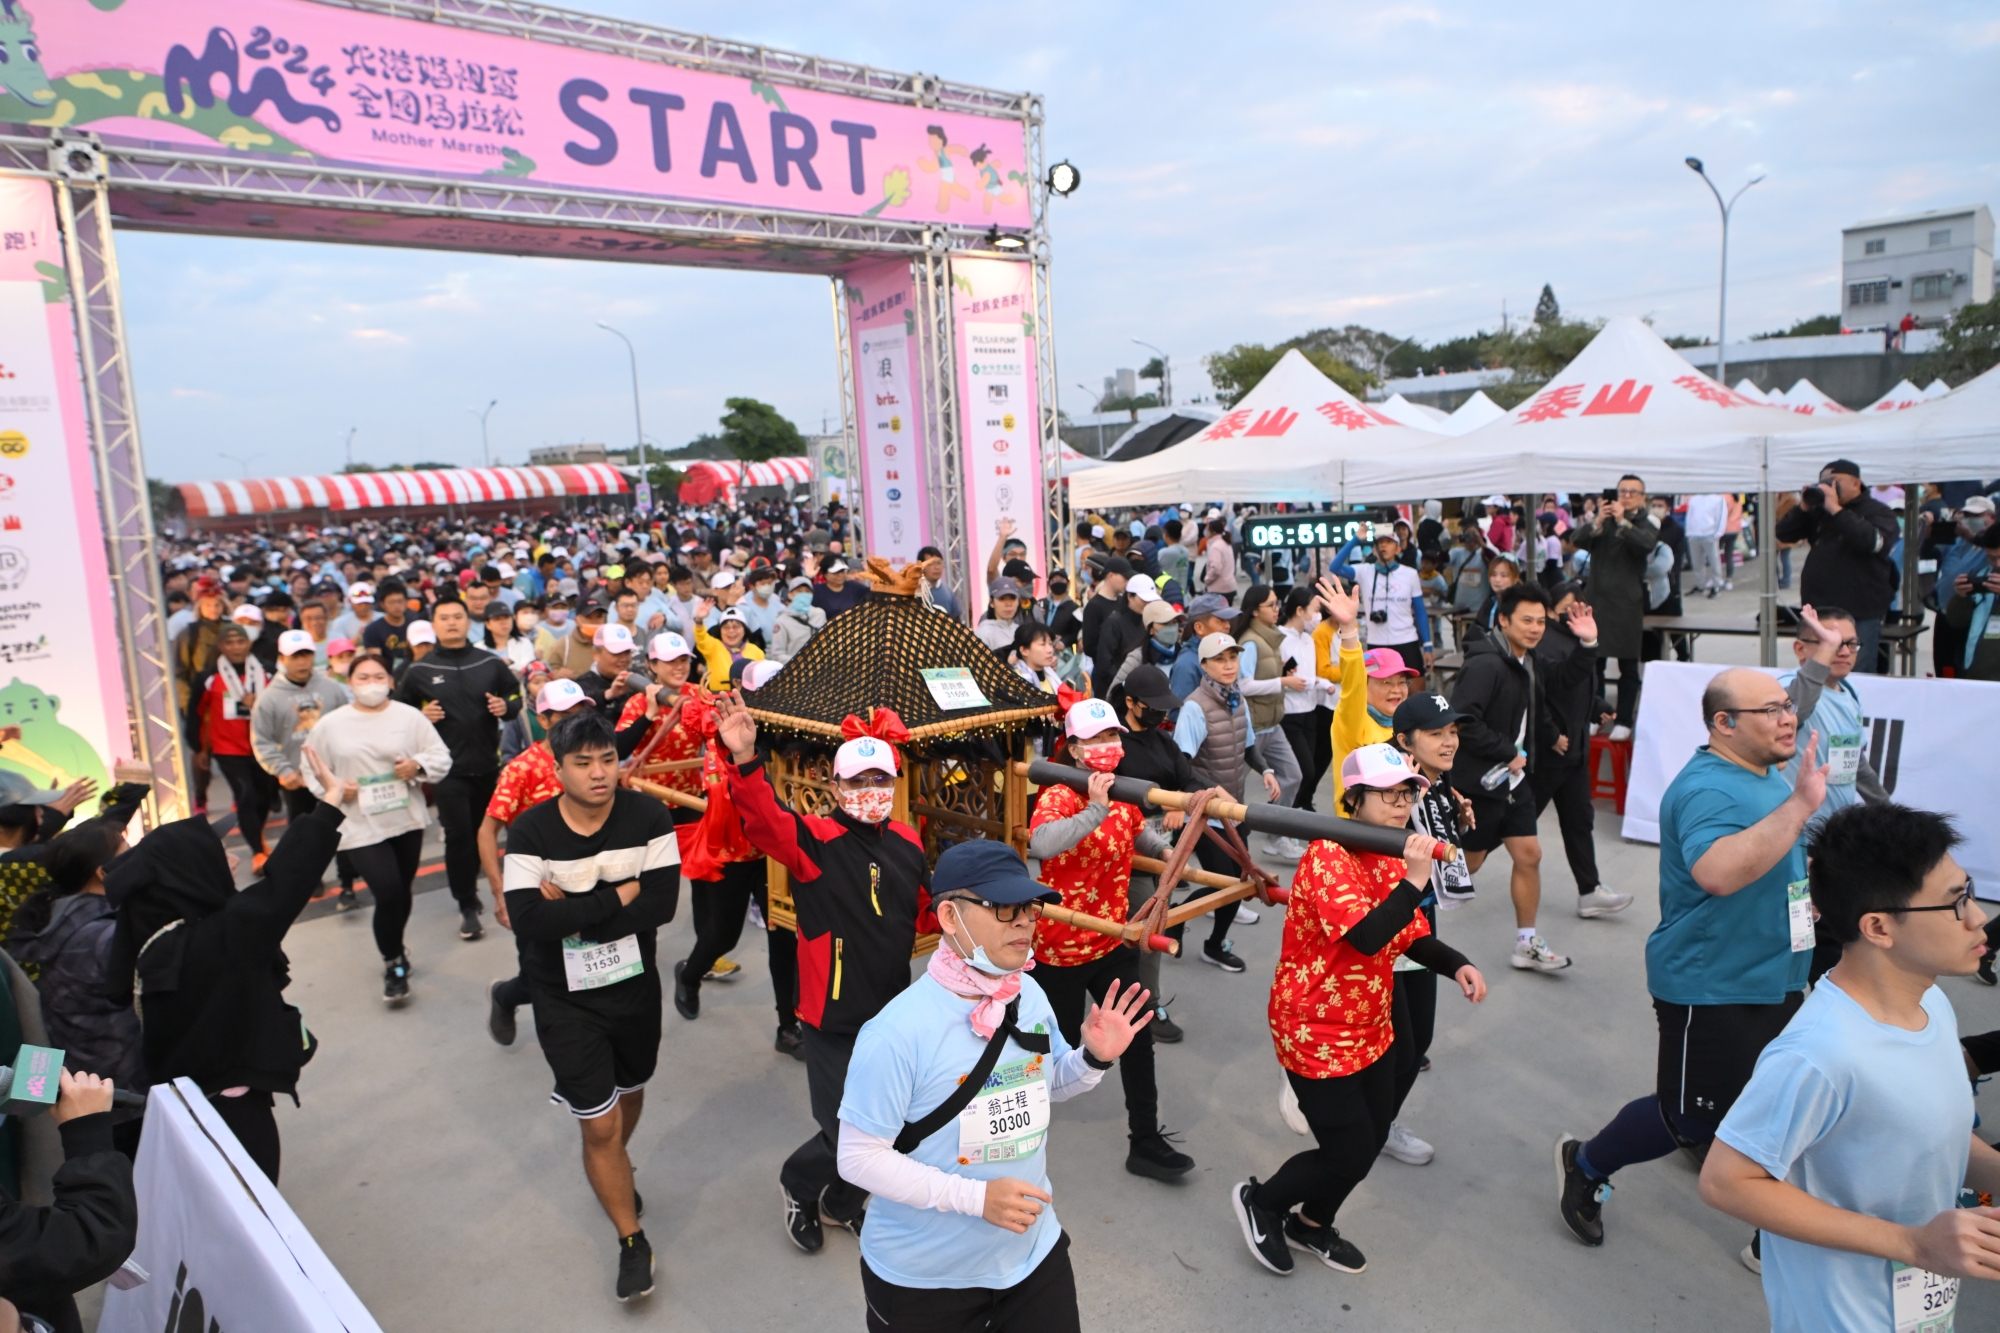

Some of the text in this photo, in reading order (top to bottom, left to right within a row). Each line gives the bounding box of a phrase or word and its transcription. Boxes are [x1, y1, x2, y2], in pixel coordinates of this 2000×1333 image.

[244, 25, 336, 98] 2024
[349, 82, 525, 136] 全國馬拉松
[371, 128, 435, 149] Mother
[558, 77, 878, 196] START
[1511, 379, 1654, 426] 泰山
[1198, 406, 1300, 443] 泰山
[585, 954, 621, 973] 31530
[988, 1090, 1028, 1117] 翁士程
[989, 1111, 1031, 1135] 30300
